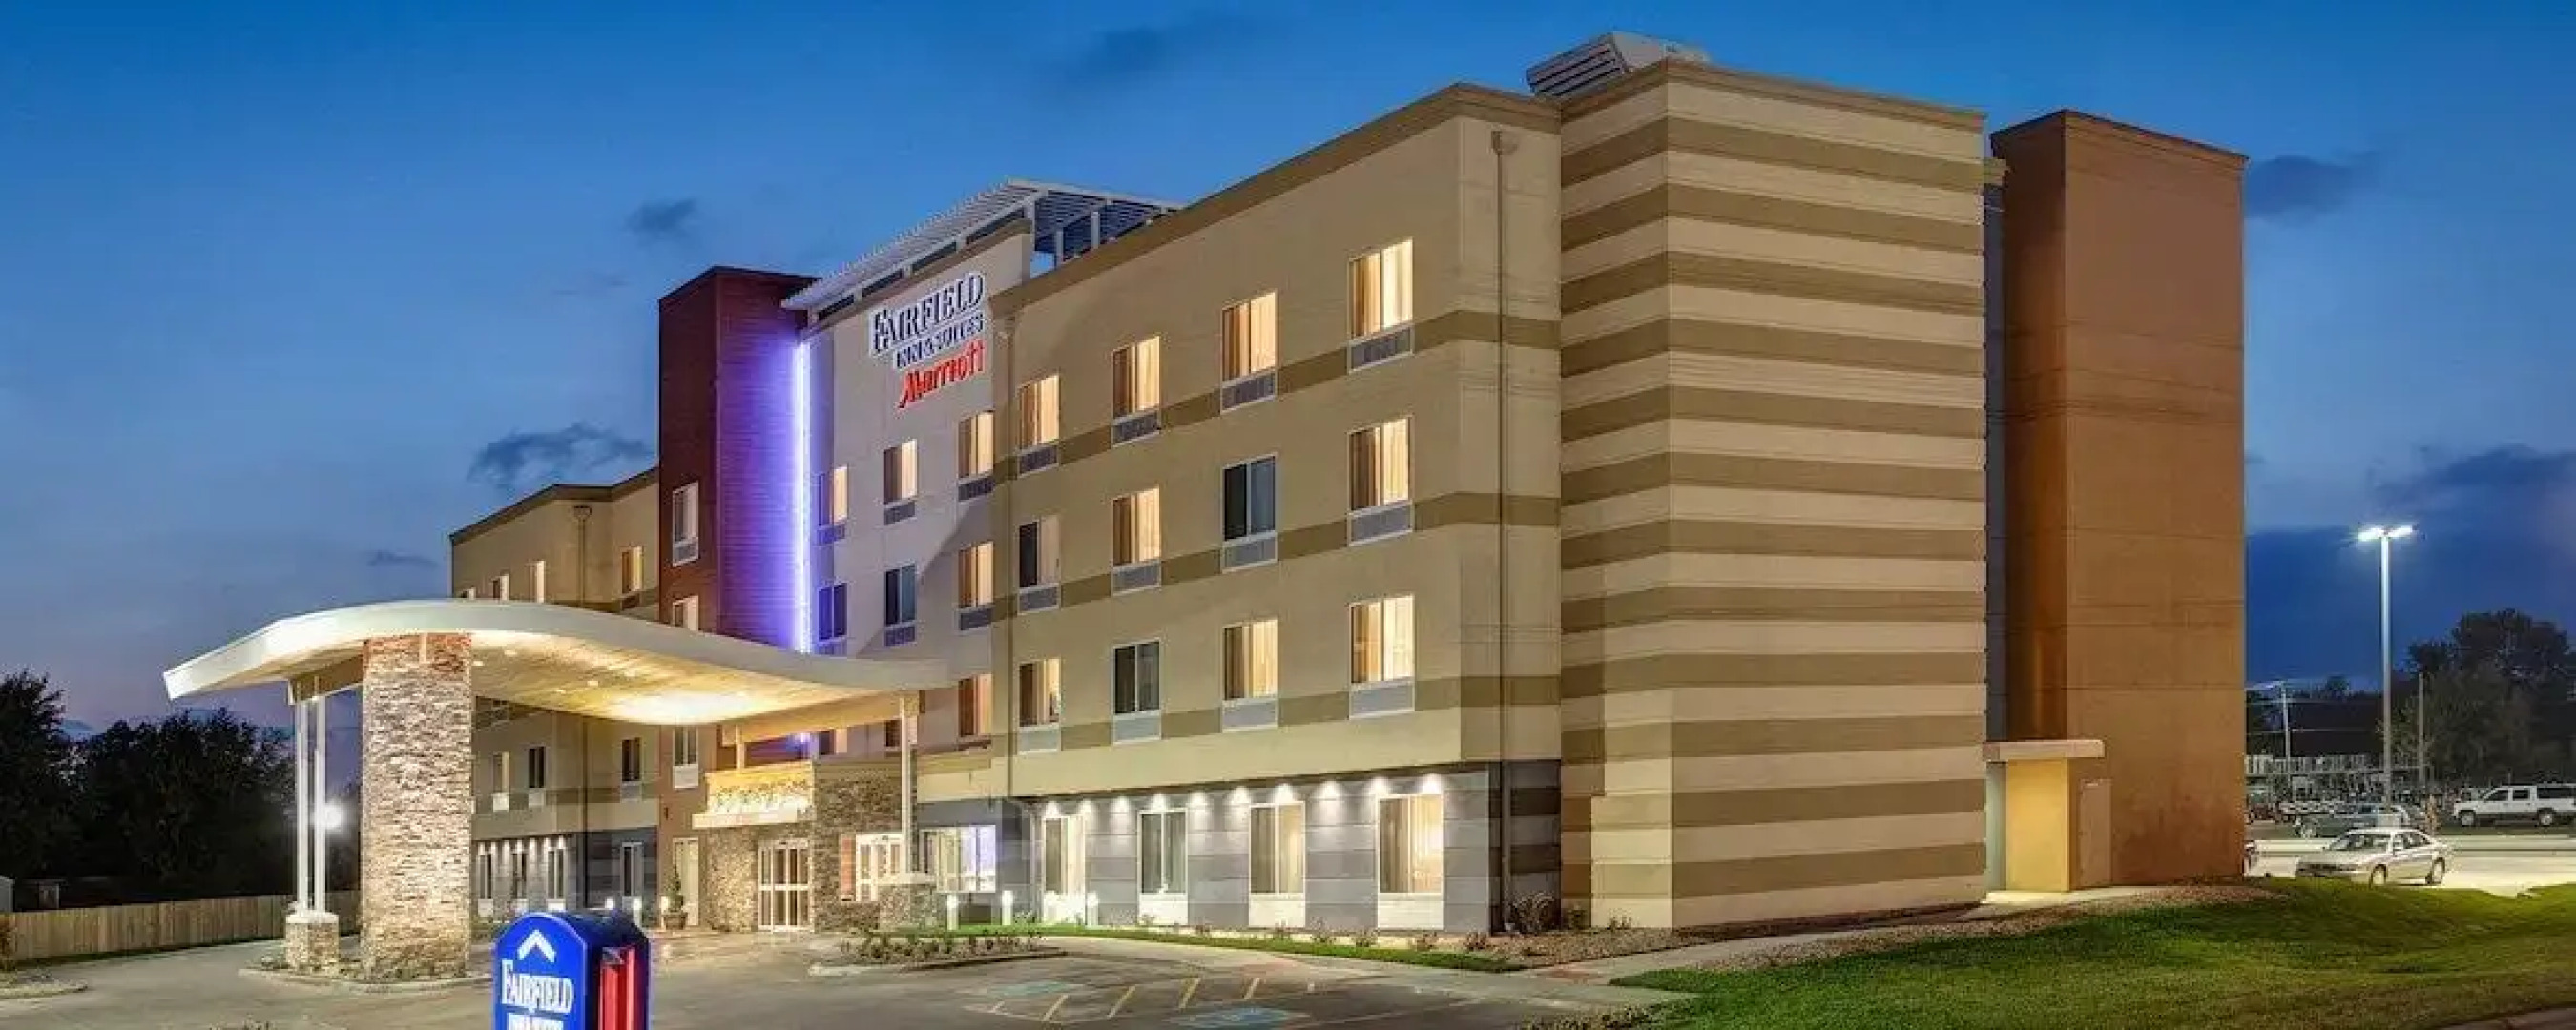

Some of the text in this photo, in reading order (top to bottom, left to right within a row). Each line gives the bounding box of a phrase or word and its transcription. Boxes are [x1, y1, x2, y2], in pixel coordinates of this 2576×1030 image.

[869, 272, 985, 356] FAIRFIELD
[897, 338, 986, 409] Marriott
[501, 959, 574, 1014] FAIRFIELD
